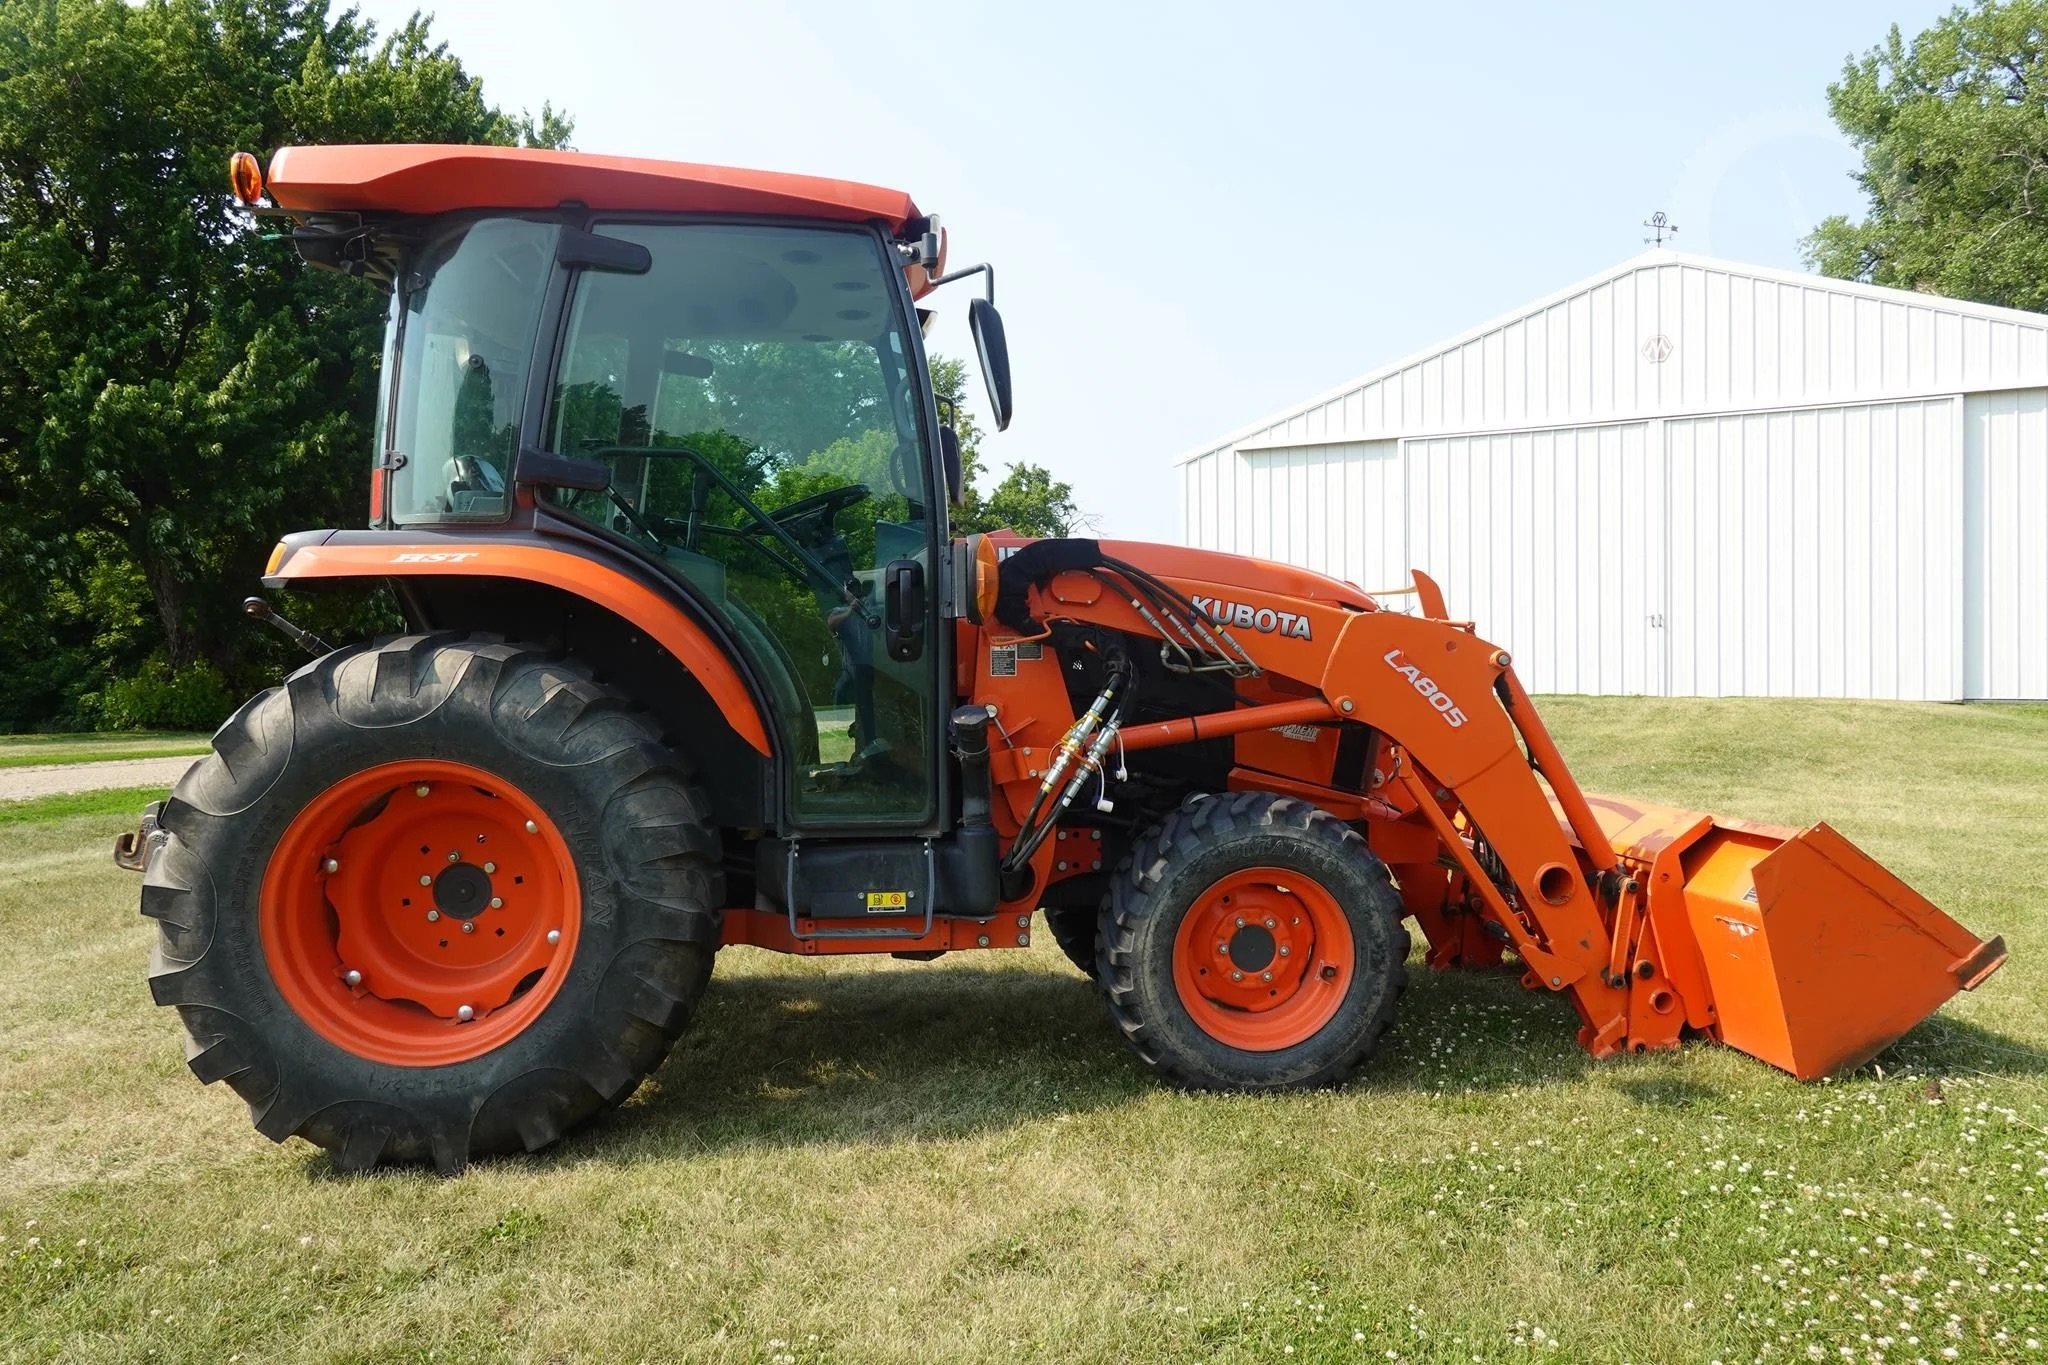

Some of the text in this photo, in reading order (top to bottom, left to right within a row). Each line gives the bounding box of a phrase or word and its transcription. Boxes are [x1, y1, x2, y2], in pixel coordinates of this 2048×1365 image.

[390, 552, 479, 563] HST
[1191, 595, 1312, 641] KUBOTA
[1383, 649, 1468, 727] LA805
